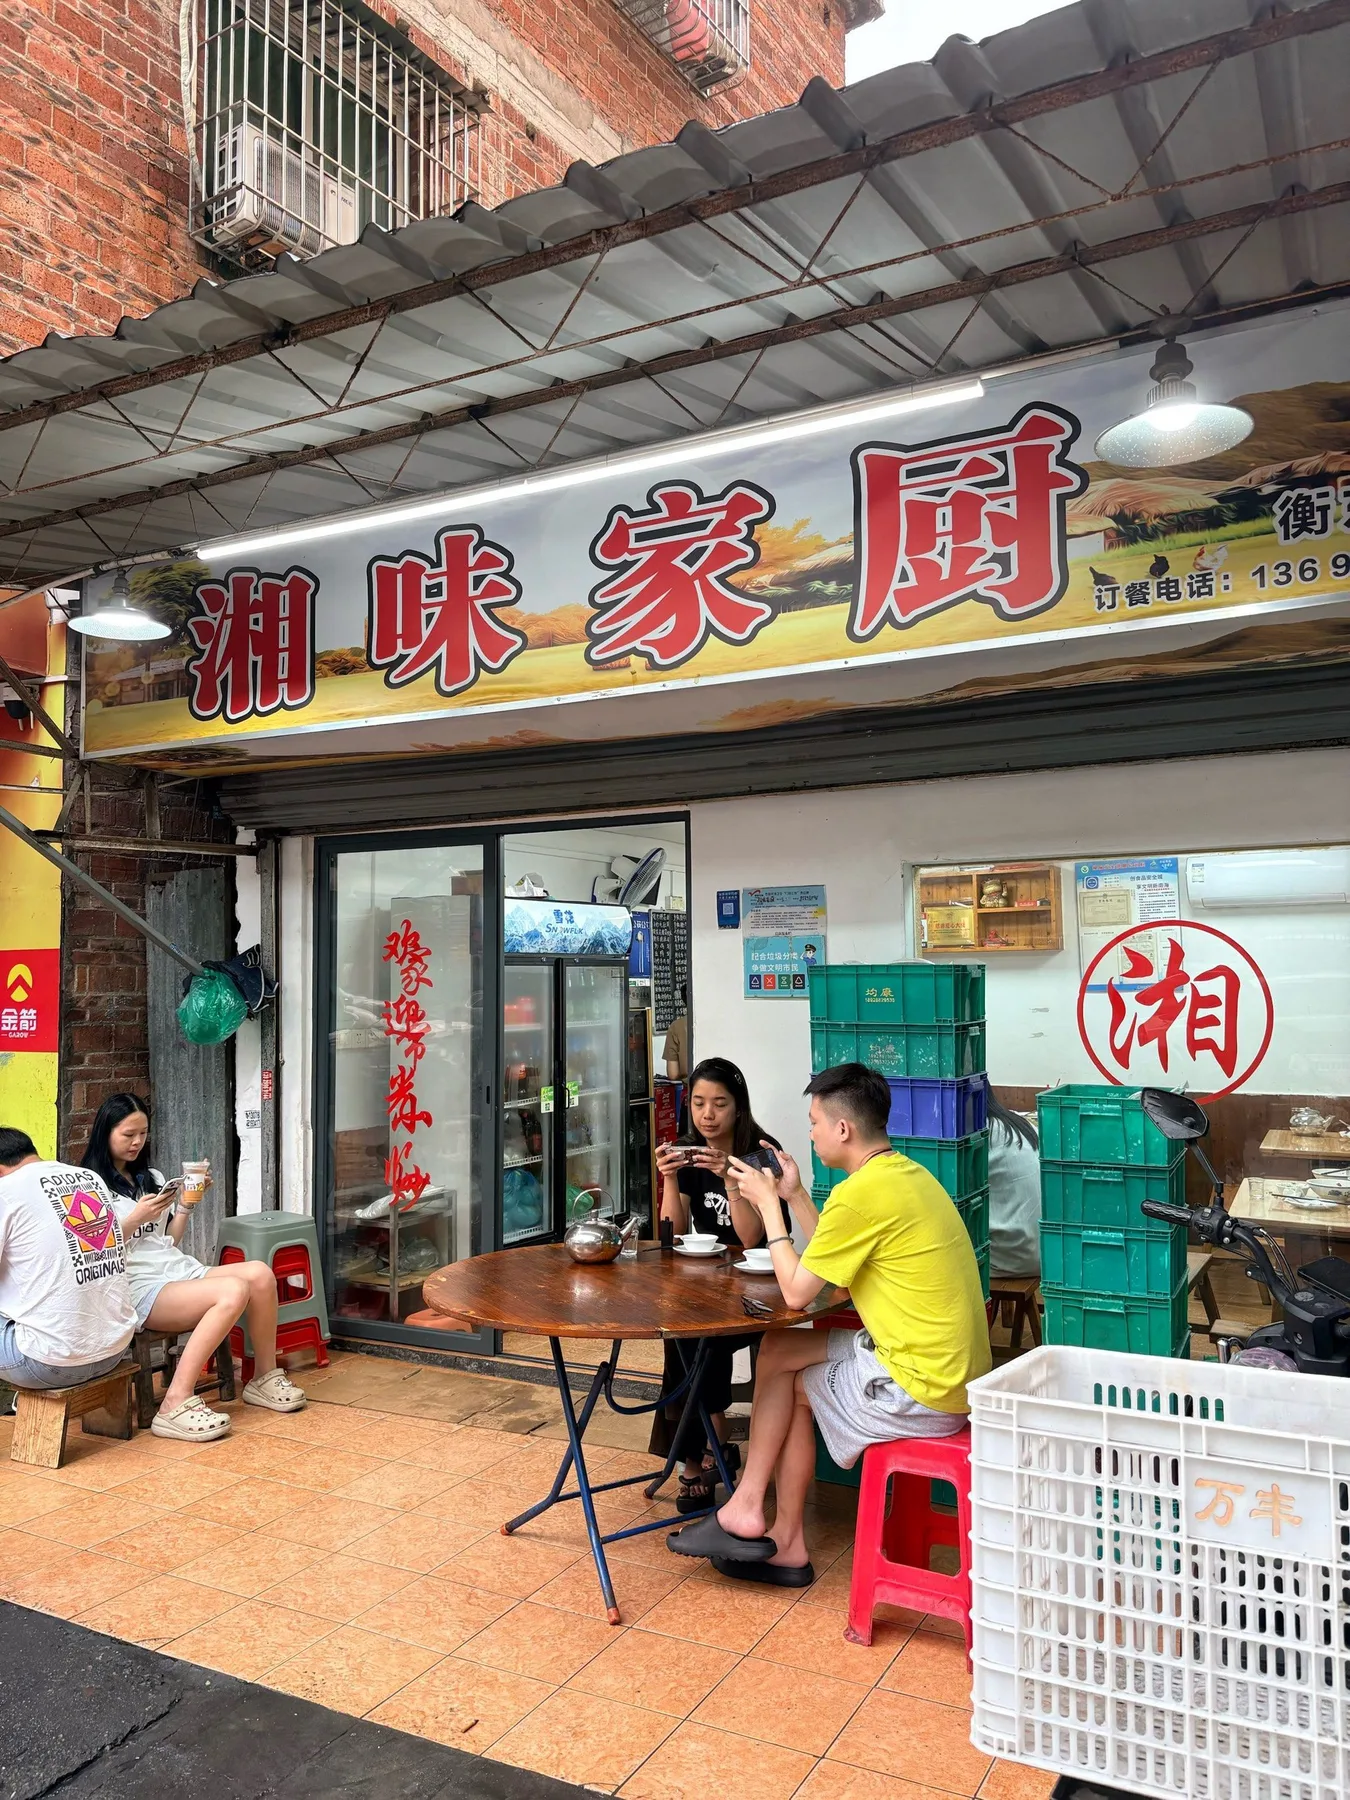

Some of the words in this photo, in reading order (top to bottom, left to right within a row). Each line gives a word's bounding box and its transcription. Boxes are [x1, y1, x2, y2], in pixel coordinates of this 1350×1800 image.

[188, 404, 1086, 721] 湘味家厨
[553, 909, 575, 925] 雪花
[751, 952, 799, 961] 配合垃圾分类
[751, 963, 799, 972] 争做文明市民
[1, 1007, 37, 1031] 金箭
[1107, 937, 1241, 1079] 湘
[40, 1170, 93, 1189] ADIDAS
[76, 1259, 125, 1286] ORIGINALS
[1194, 1477, 1303, 1538] 万丰
